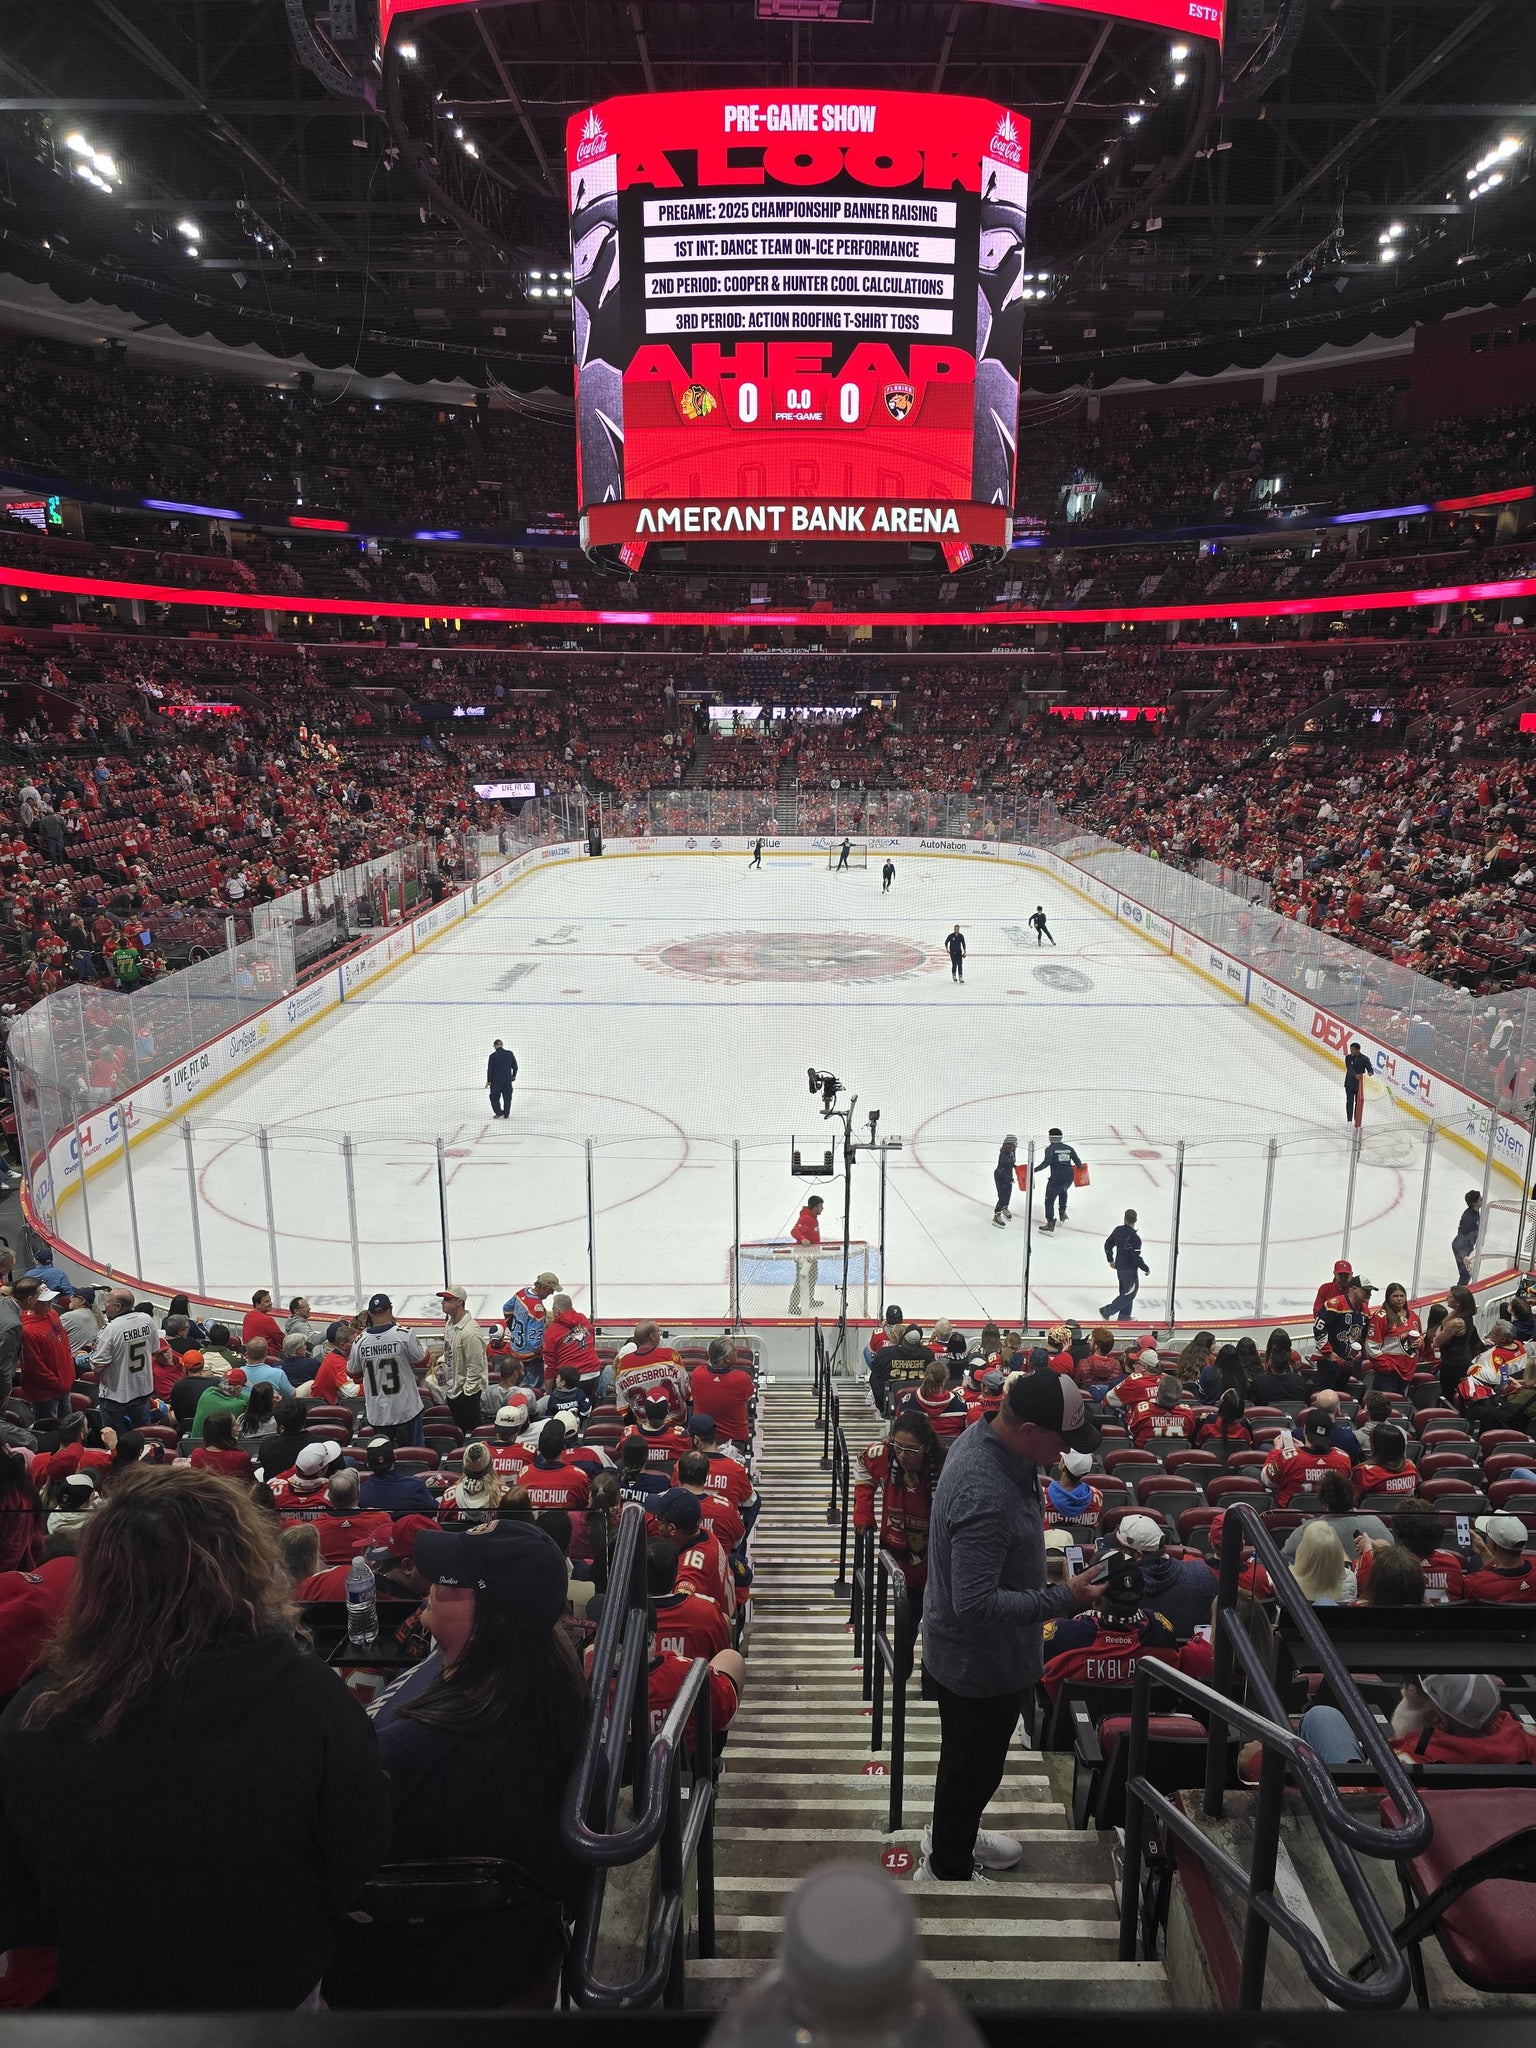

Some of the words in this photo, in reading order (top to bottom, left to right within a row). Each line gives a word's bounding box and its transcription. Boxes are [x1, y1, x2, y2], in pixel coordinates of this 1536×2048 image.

[724, 104, 819, 132] PRE-GAME
[821, 104, 876, 133] SHOW
[658, 203, 717, 221] PREGAME:
[718, 202, 749, 219] 2025
[751, 201, 841, 219] CHAMPIONSHIP
[844, 202, 889, 220] BANNER
[892, 204, 938, 222] RAISING
[674, 240, 694, 257] 1ST
[696, 240, 719, 257] INT:
[720, 238, 759, 256] DANCE
[761, 238, 793, 255] TEAM
[795, 238, 834, 255] ON-ICE
[836, 239, 920, 258] PERFORMANCE
[651, 278, 674, 295] 2ND
[677, 276, 722, 294] PERIOD:
[724, 275, 769, 292] COOPER
[771, 275, 781, 292] &
[783, 275, 828, 292] HUNTER
[831, 276, 860, 293] COOL
[862, 276, 944, 296] CALCULATIONS
[676, 313, 699, 330] 3RD
[701, 312, 746, 329] PERIOD:
[748, 311, 790, 329] ACTION
[792, 311, 842, 328] ROOFING
[844, 312, 889, 330] T-SHIRT
[890, 313, 920, 331] TOSS
[622, 341, 978, 382] AHEAD
[738, 382, 759, 423] 0
[786, 388, 812, 410] 0.0
[839, 382, 861, 424] 0
[775, 411, 823, 421] PRE-GAME
[635, 505, 786, 534] AMERANT
[791, 505, 865, 532] BANK
[870, 506, 960, 534] ARENA
[920, 840, 967, 851] AutoNation
[1311, 1012, 1354, 1056] DEX
[174, 1068, 189, 1087] LIVE.
[123, 1325, 151, 1341] EKBLAD
[129, 1340, 146, 1374] 5
[360, 1342, 398, 1357] REINHART
[364, 1357, 400, 1397] 13
[1151, 1416, 1185, 1427] TKACHUK
[1386, 1476, 1416, 1491] BARKOV
[527, 1489, 569, 1503] TKACHUK
[683, 1550, 705, 1570] 16
[1105, 1636, 1133, 1644] Reebok
[886, 1853, 908, 1868] 15
